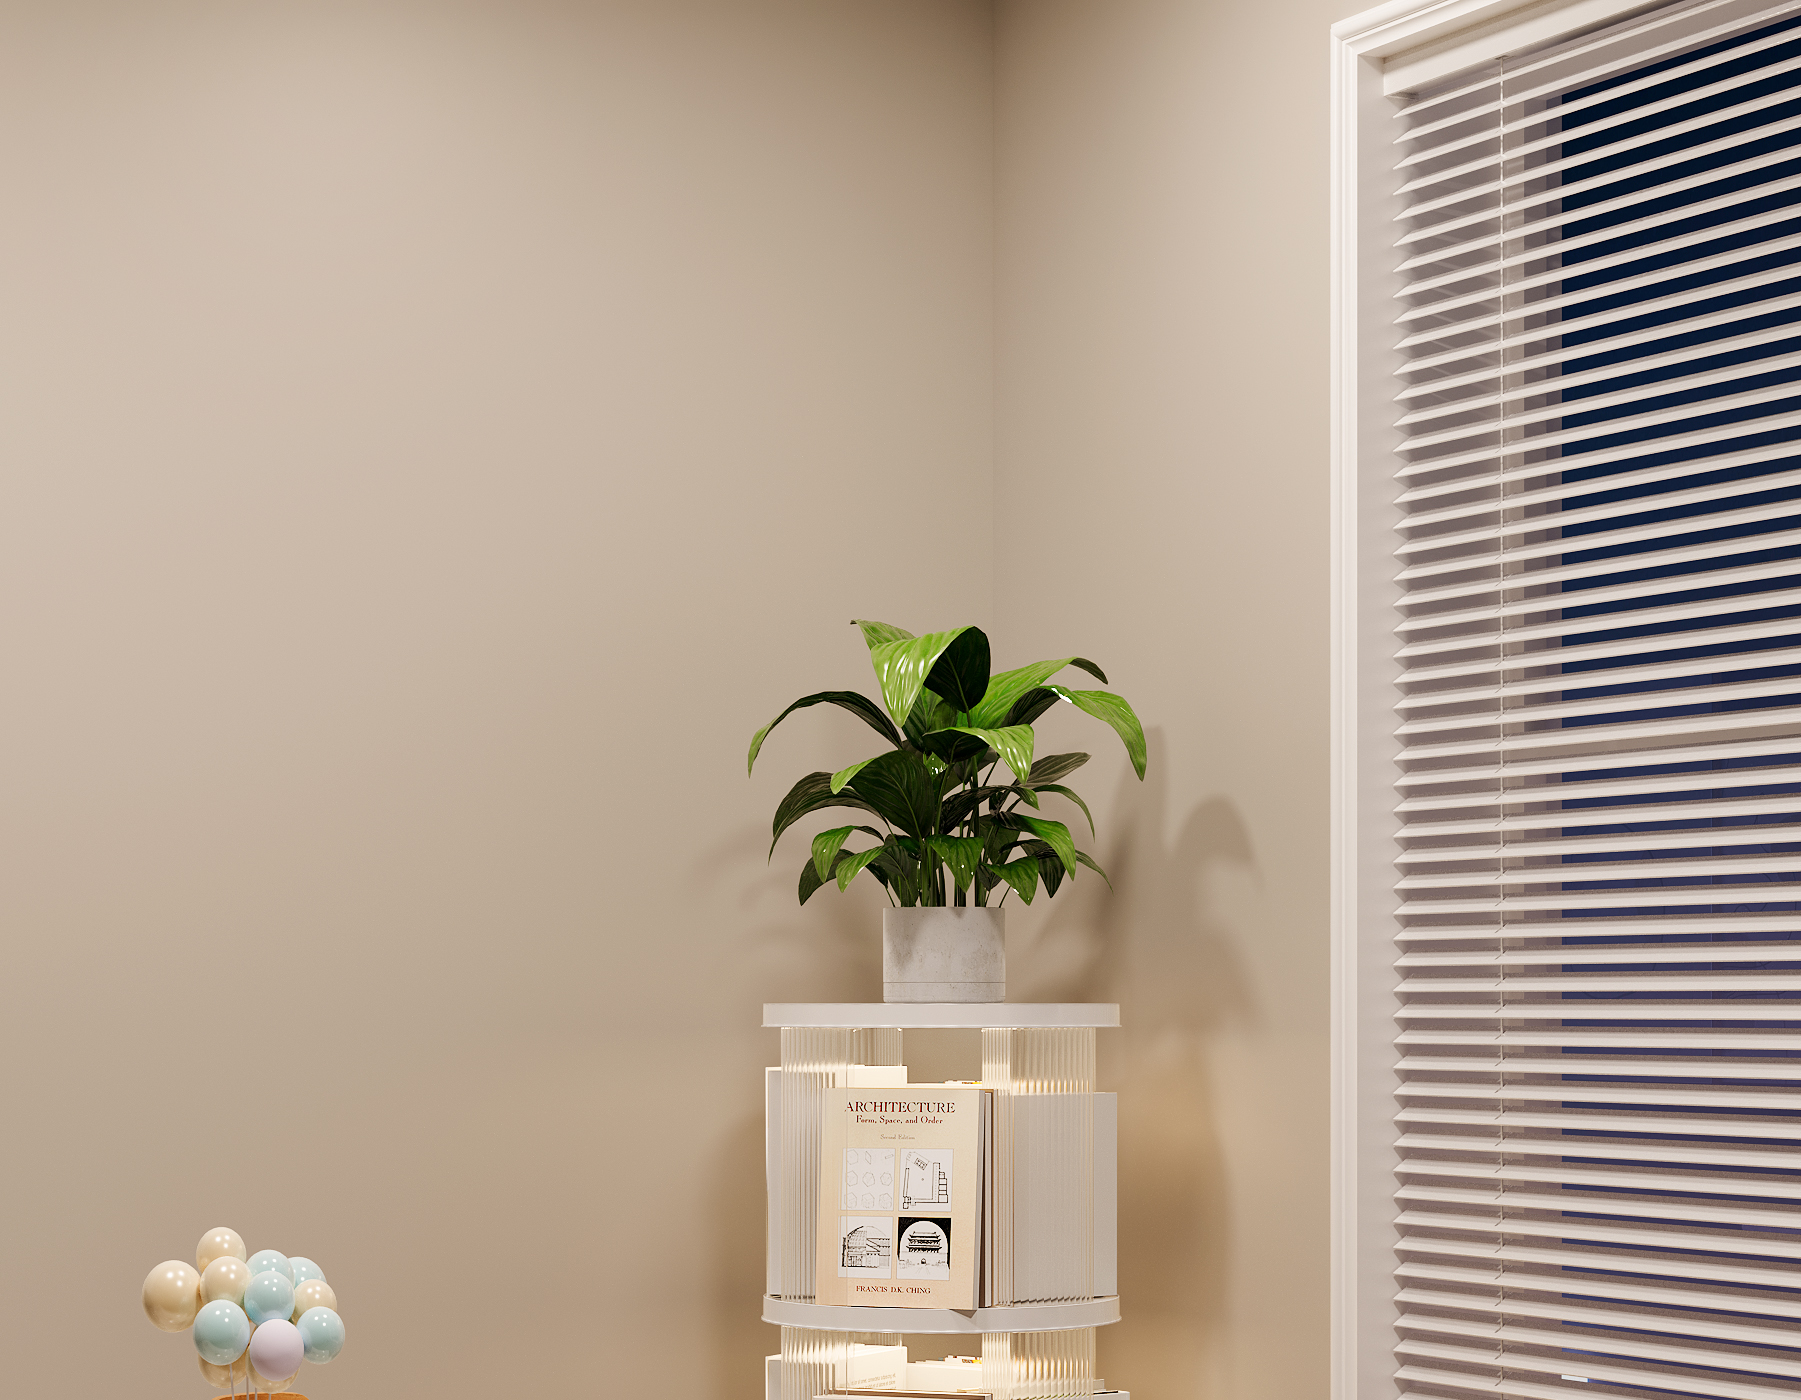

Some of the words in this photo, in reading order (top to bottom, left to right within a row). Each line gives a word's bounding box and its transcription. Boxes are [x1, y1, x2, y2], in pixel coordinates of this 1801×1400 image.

[845, 1101, 956, 1113] ARCHITECTURE
[879, 1115, 903, 1125] Space,
[905, 1116, 918, 1124] and
[920, 1116, 943, 1124] Order
[856, 1285, 888, 1293] FRANCIS
[906, 1287, 931, 1295] CHING
